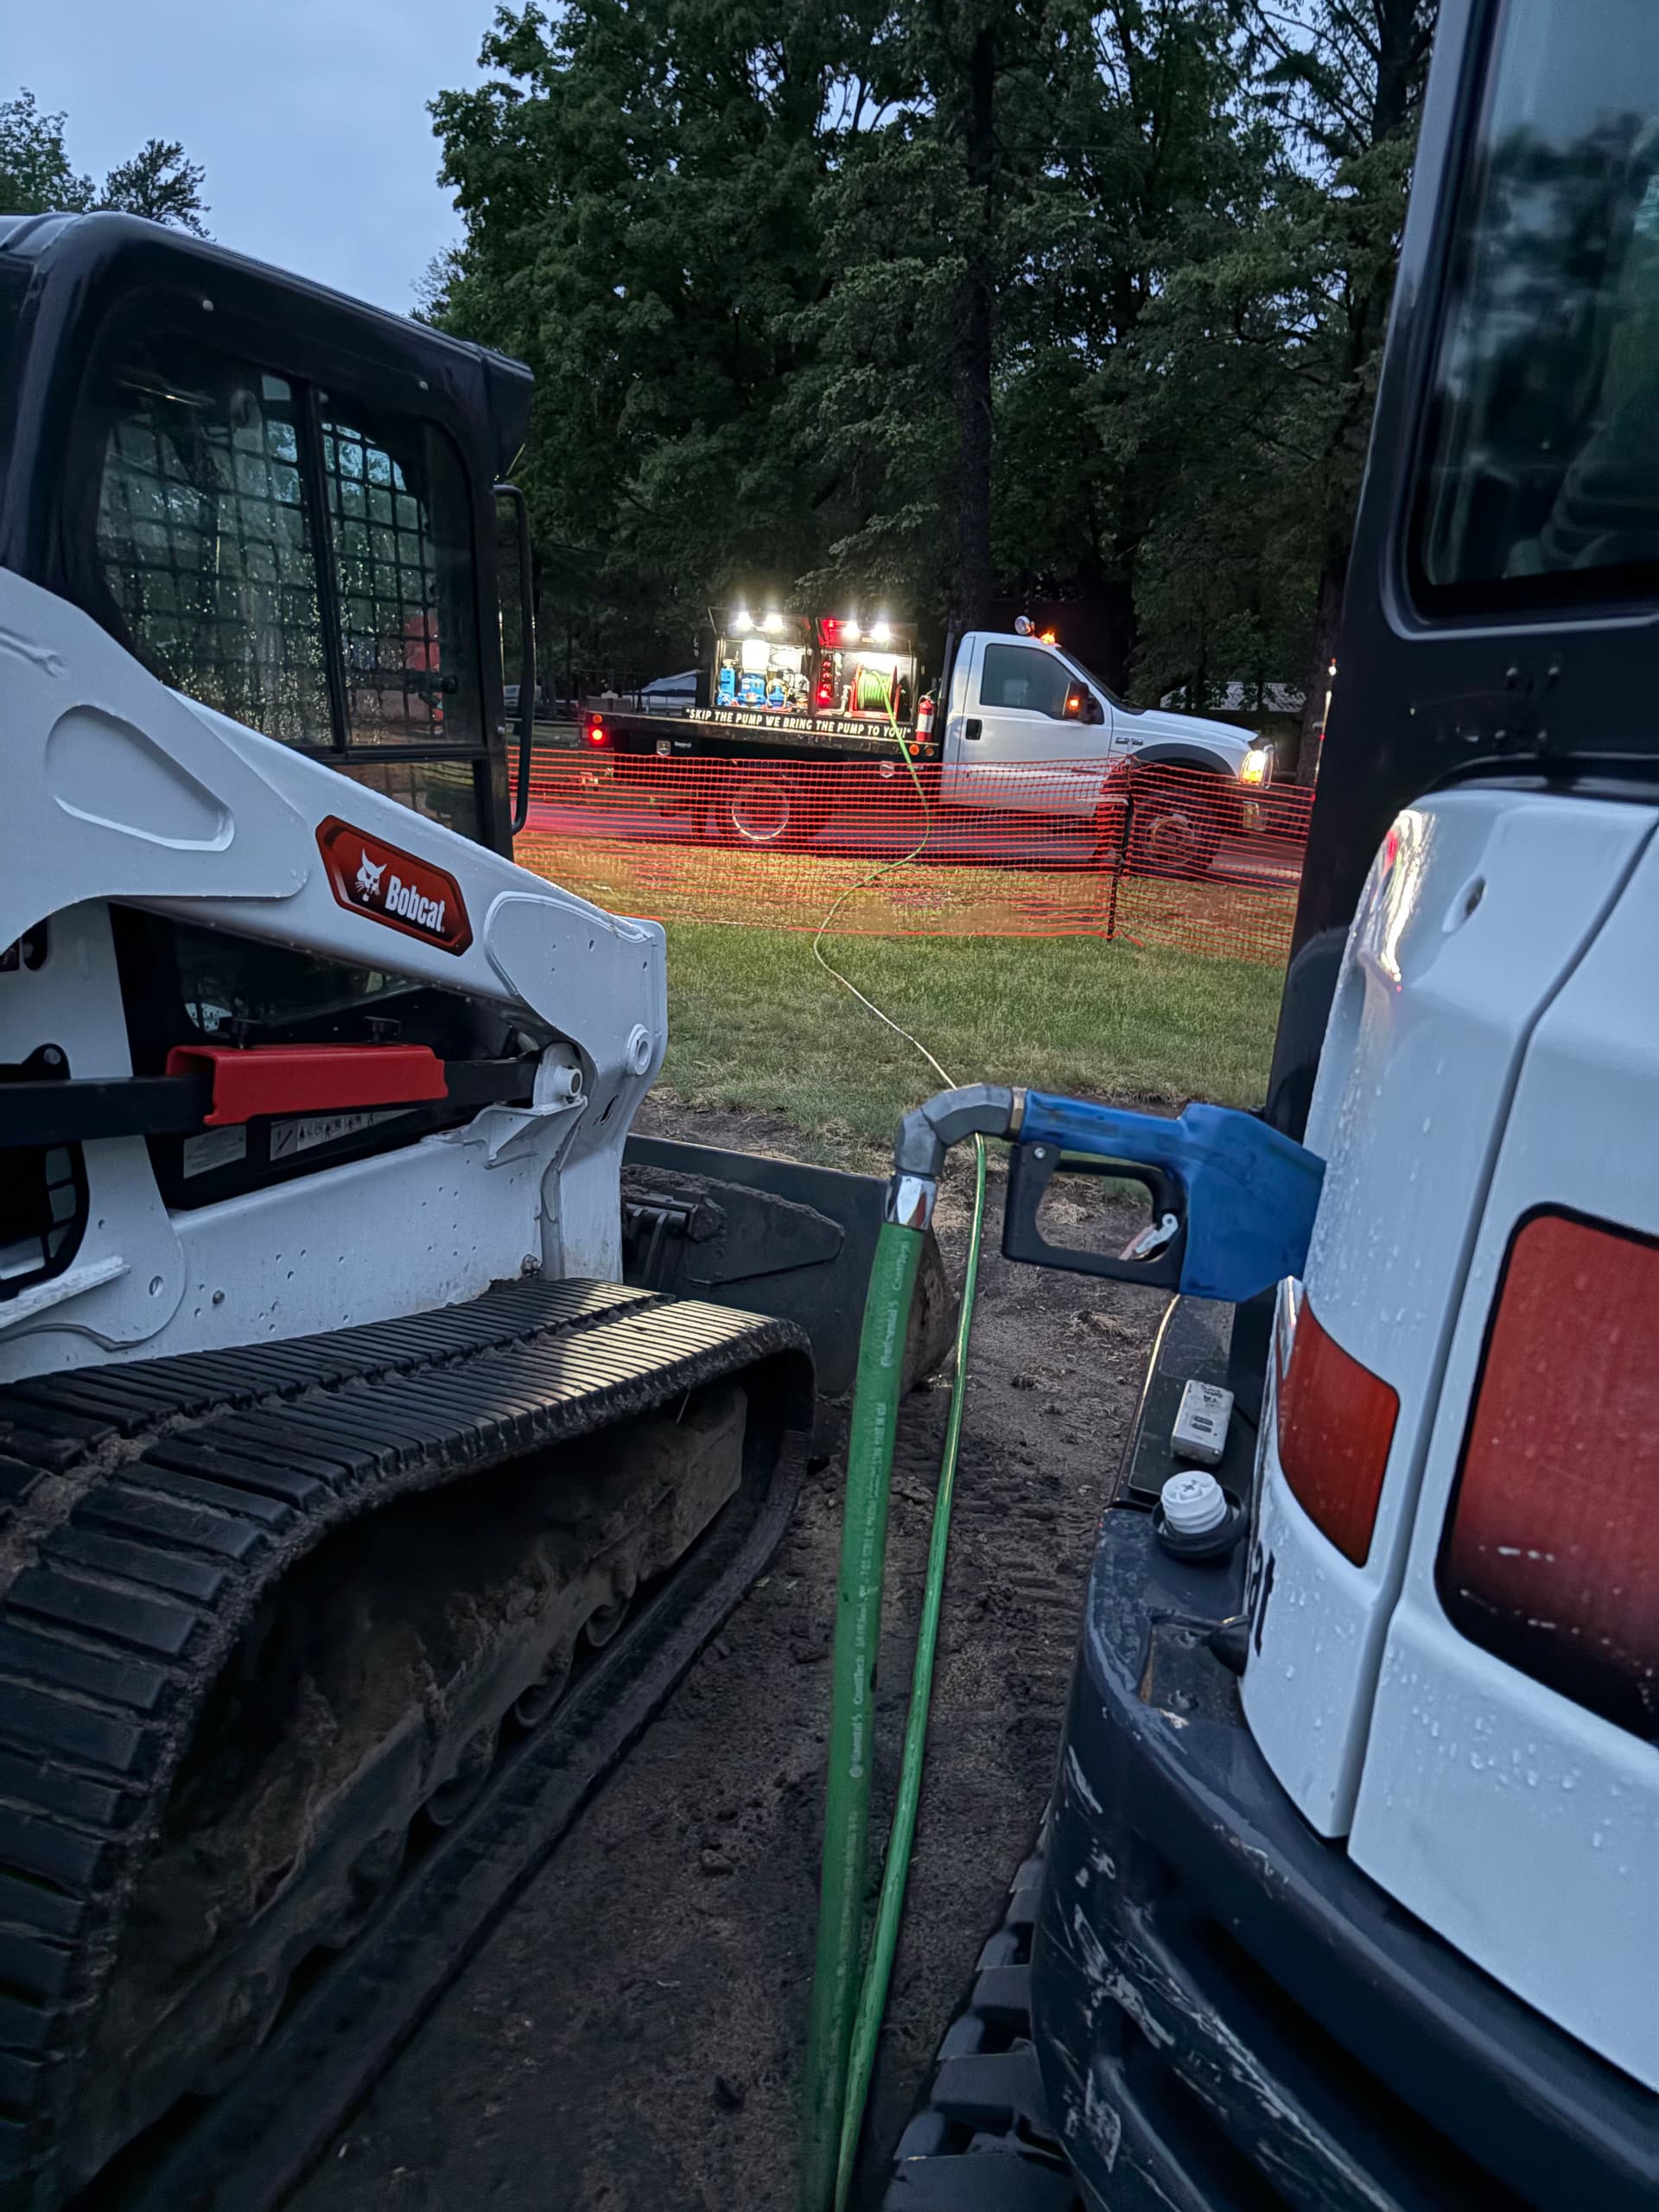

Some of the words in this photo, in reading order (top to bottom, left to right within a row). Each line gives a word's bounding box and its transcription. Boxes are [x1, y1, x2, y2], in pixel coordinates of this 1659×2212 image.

[715, 710, 734, 722] THE
[735, 714, 763, 726] PUMP
[766, 716, 781, 728] WE
[783, 717, 812, 730] BRING
[816, 720, 835, 732] THE
[836, 722, 864, 737] PUMP
[867, 725, 880, 737] TO
[385, 874, 445, 932] Bobcat
